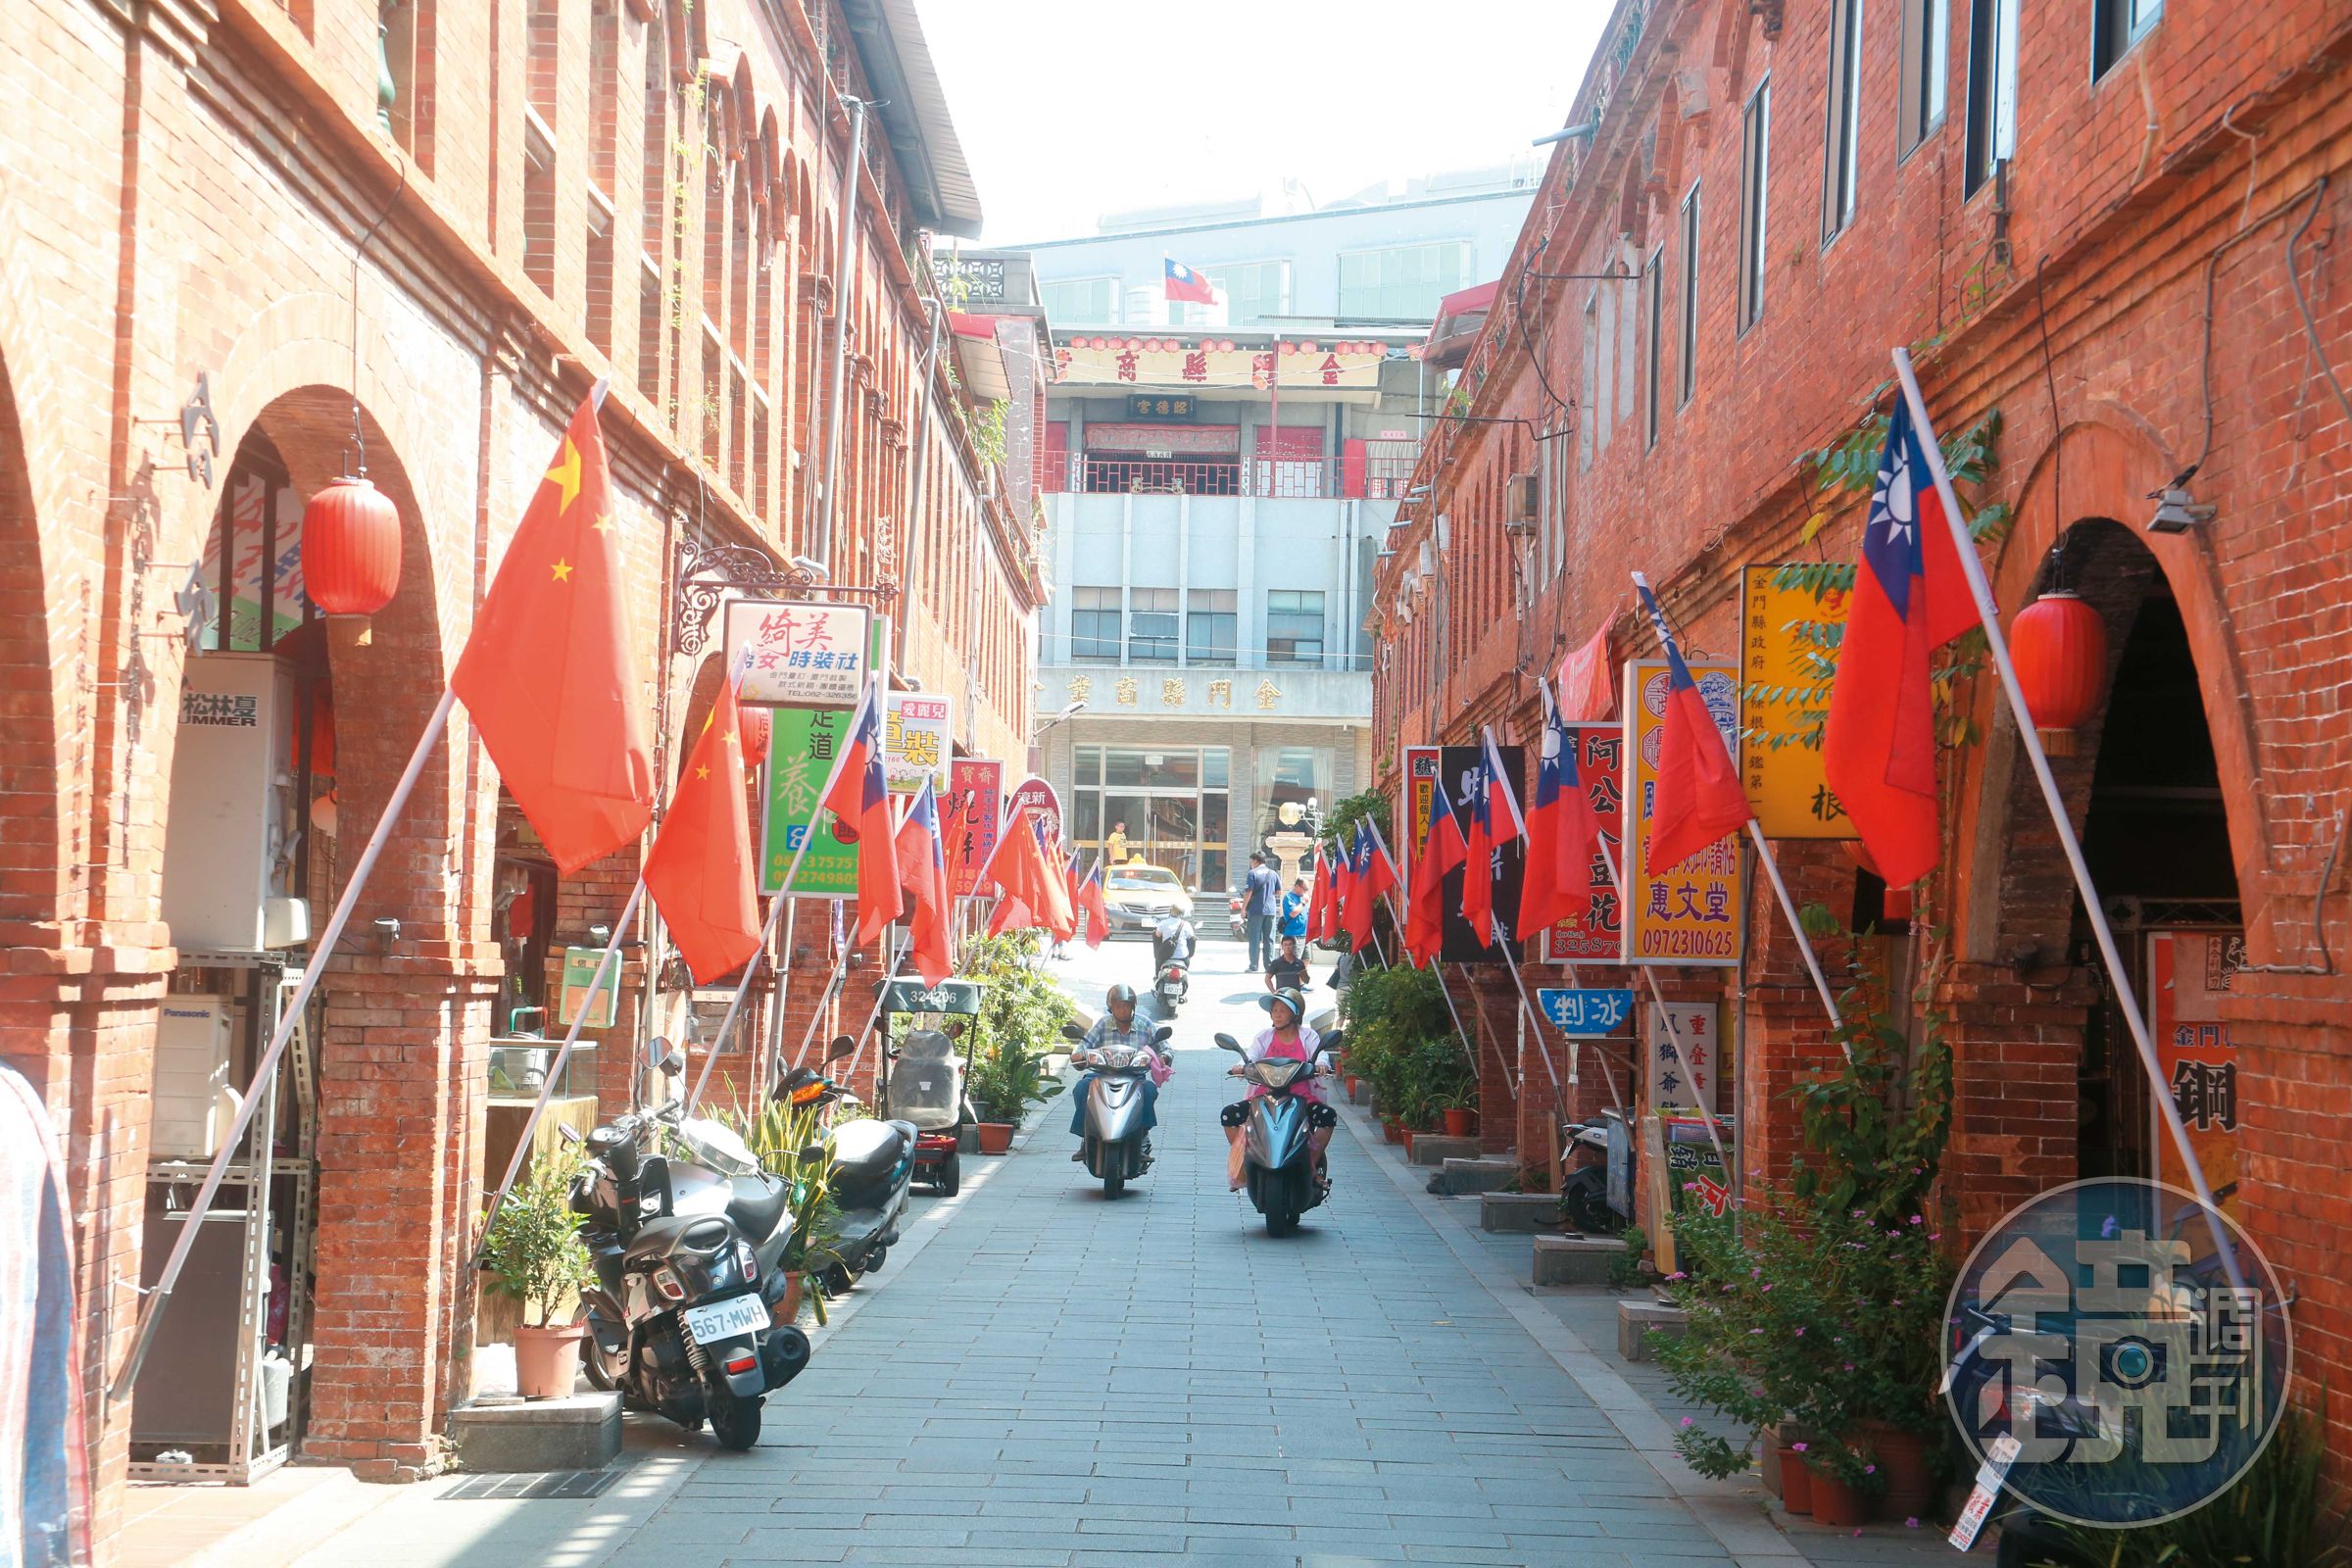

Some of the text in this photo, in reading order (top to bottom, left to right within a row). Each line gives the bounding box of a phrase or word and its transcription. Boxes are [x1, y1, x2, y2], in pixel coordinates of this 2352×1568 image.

[1054, 349, 1347, 385] 金門縣商
[1137, 400, 1189, 416] 昭德宮
[1034, 674, 1283, 710] 金門縣商業
[183, 693, 258, 716] 松林夏
[903, 703, 946, 718] 愛麗兒
[178, 715, 257, 726] UMMER
[950, 765, 995, 785] 寶齋
[773, 855, 858, 869] 08-37575
[1646, 880, 1731, 923] 惠文堂
[1642, 928, 1734, 956] 0972310625
[910, 991, 957, 1004] 324206
[164, 1007, 211, 1018] Panasonic
[2173, 1024, 2236, 1049] 金門
